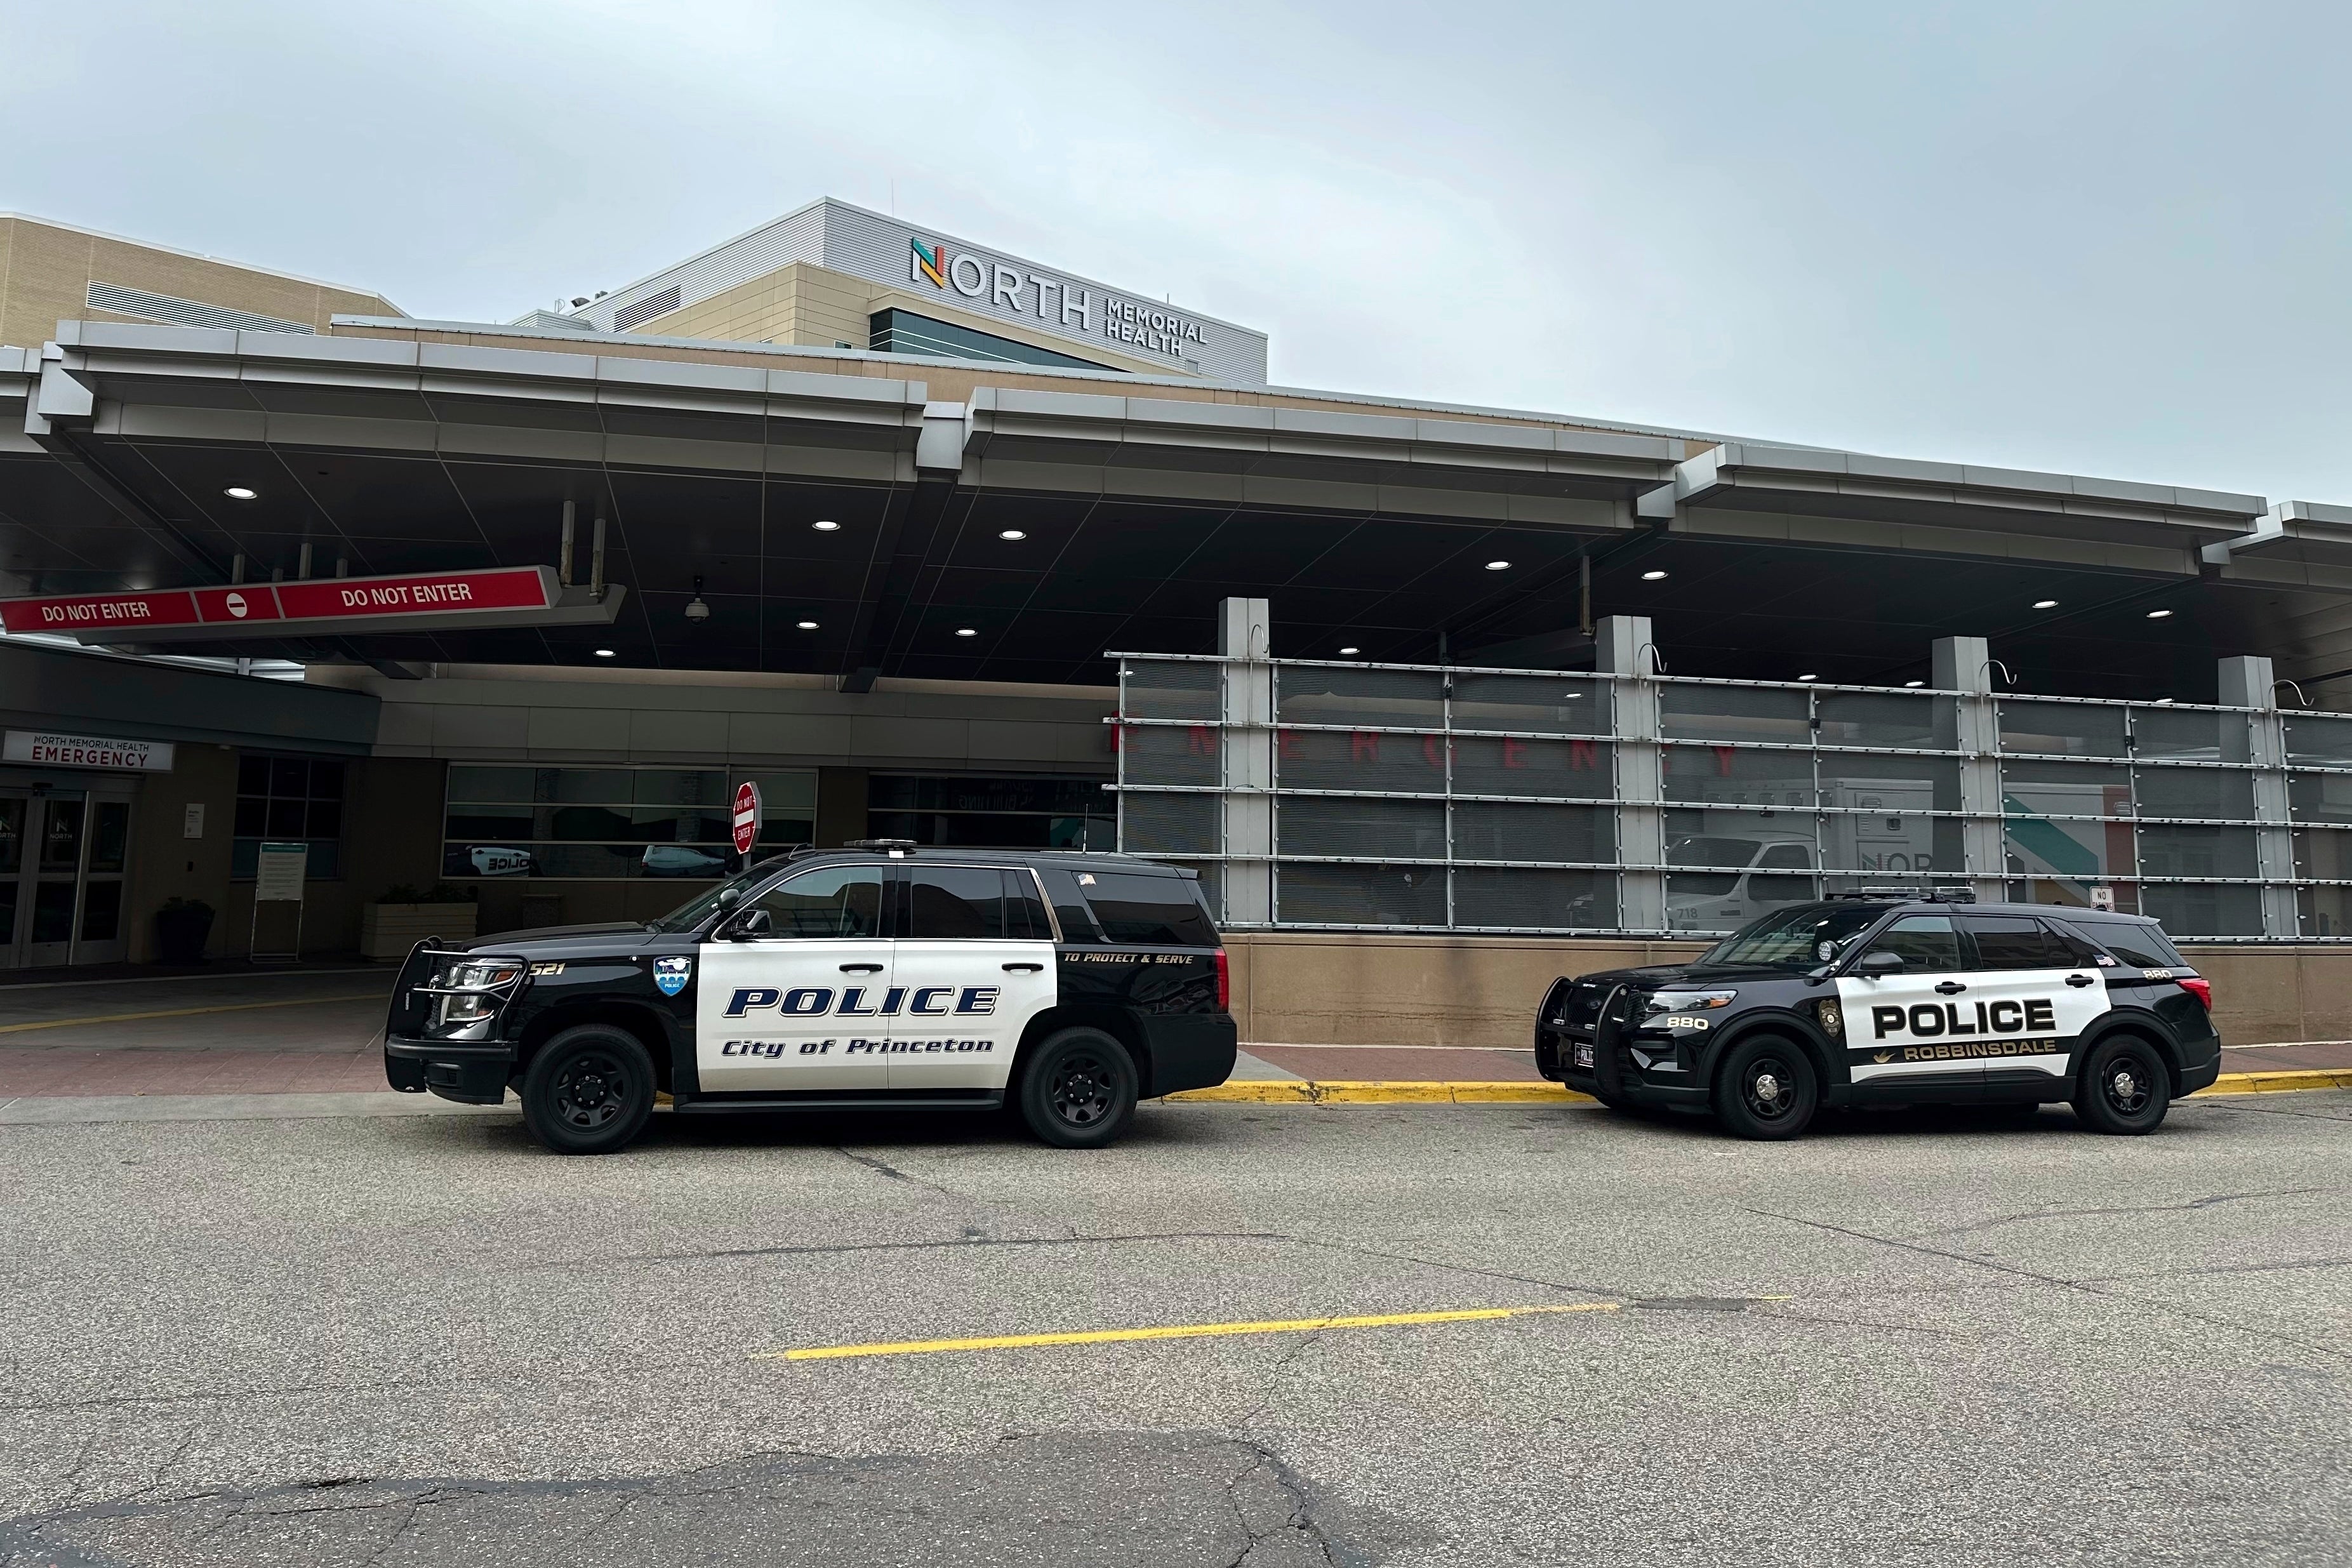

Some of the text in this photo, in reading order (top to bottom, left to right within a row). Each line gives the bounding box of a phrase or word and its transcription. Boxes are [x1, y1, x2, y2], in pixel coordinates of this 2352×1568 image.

[912, 236, 1091, 330] NORTH
[1106, 298, 1208, 344] MEMORIAL
[1106, 318, 1183, 356] HEALTH
[341, 583, 473, 607] DO NOT ENTER
[41, 602, 151, 622] DO NOT ENTER
[34, 735, 150, 752] NORTH MEMORIAL HEALTH
[1111, 710, 1737, 777] EMERGENY
[32, 745, 148, 767] EMERGENCY
[736, 795, 753, 811] DO NOT
[738, 826, 750, 840] ENTER
[2097, 891, 2106, 900] NO
[1677, 908, 1698, 918] 718
[529, 962, 566, 976] 521
[1064, 953, 1194, 964] TO PROTECT & SERVE
[722, 985, 1001, 1018] POLICE
[1666, 1016, 1709, 1030] 880
[1871, 999, 2057, 1040] POLICE
[721, 1038, 995, 1060] City of Princeton
[1904, 1039, 2057, 1061] ROBBINSDALE
